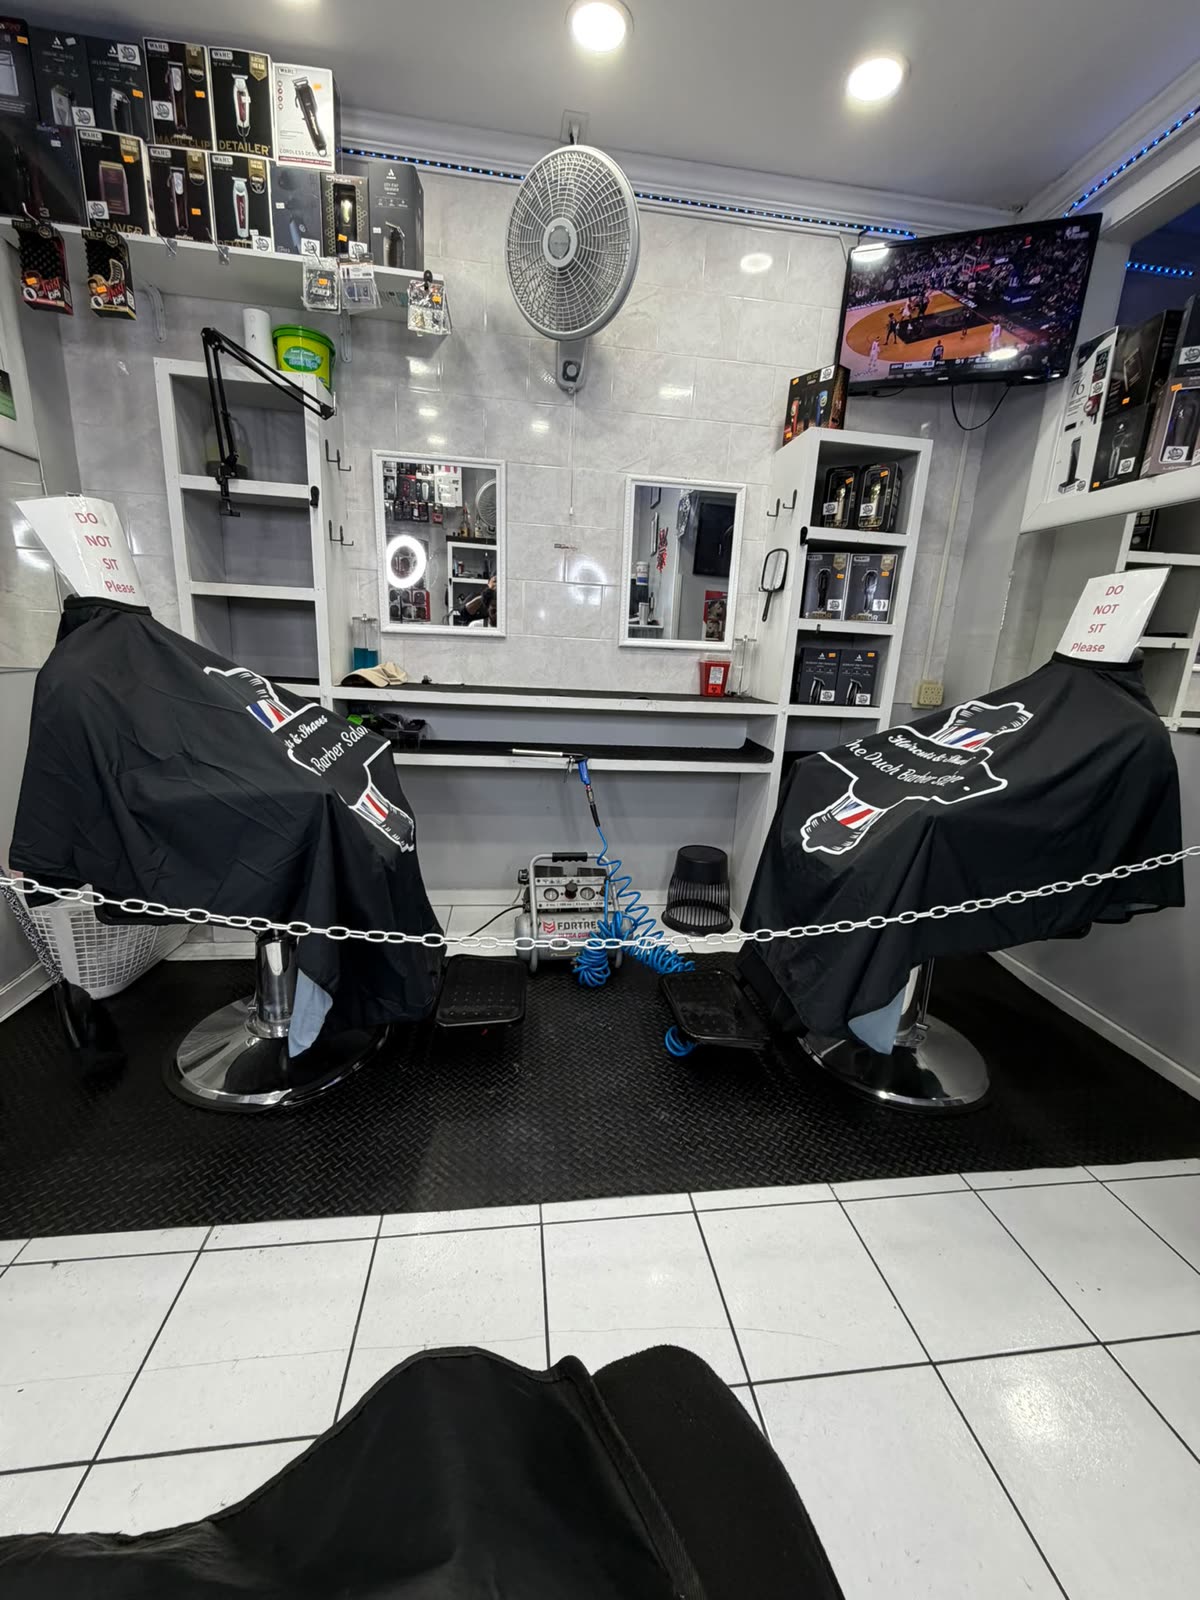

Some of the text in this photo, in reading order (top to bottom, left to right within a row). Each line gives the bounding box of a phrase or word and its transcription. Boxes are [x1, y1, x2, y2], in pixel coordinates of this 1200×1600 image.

[149, 43, 167, 51] WAHL
[213, 51, 231, 59] WAHL
[152, 149, 170, 157] WAHL
[219, 140, 268, 156] DETAILER
[213, 155, 231, 164] WAHL
[83, 230, 104, 238] RED
[75, 512, 98, 524] DO
[85, 535, 112, 548] NOT
[102, 558, 119, 571] SIT
[104, 581, 136, 594] Please
[1105, 585, 1124, 596] DO
[1093, 604, 1120, 615] NOT
[1088, 623, 1107, 634] SIT
[1070, 642, 1105, 653] Please
[289, 733, 302, 744] &
[297, 714, 328, 739] Shaves
[310, 742, 345, 772] Barber
[863, 751, 904, 776] Duch
